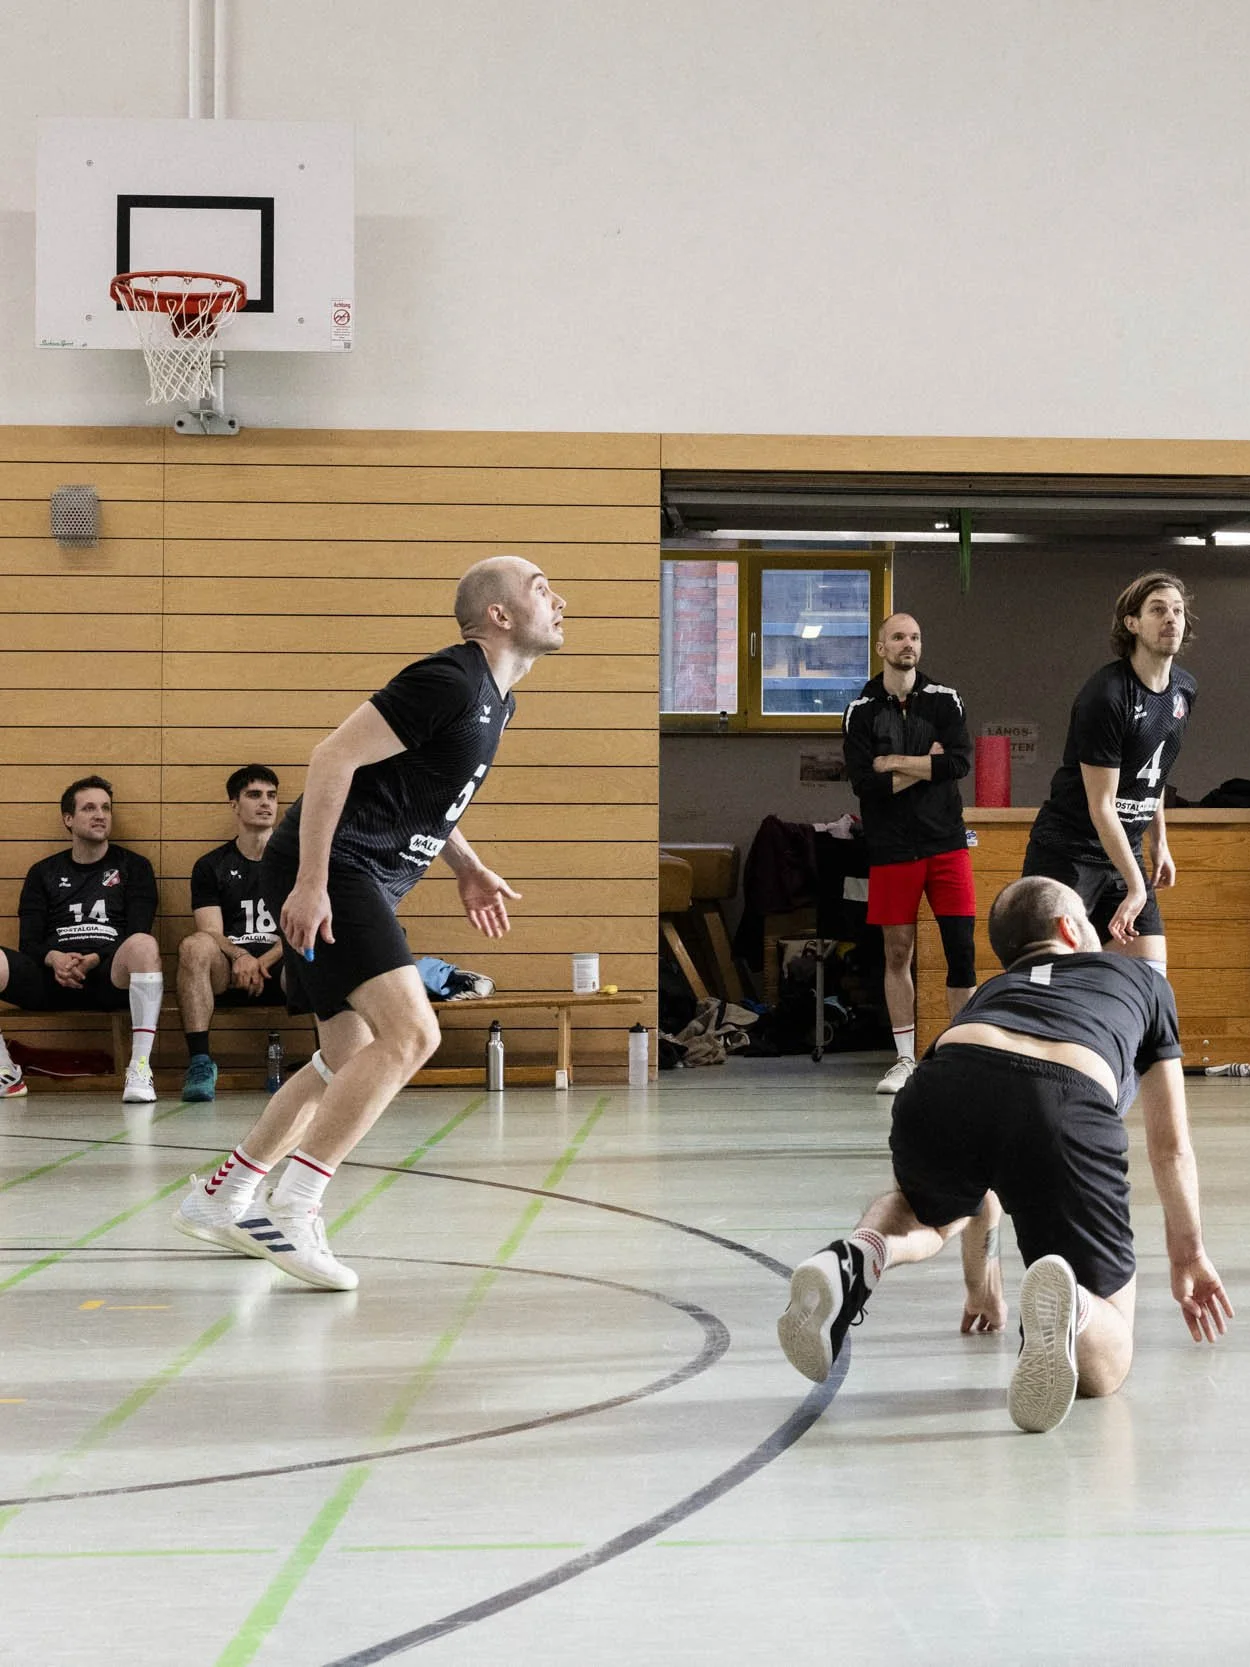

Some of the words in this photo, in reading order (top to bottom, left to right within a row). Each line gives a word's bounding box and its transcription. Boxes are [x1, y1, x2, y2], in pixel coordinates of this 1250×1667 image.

[1136, 740, 1165, 788] 4
[69, 899, 110, 923] 14
[240, 898, 277, 934] 18
